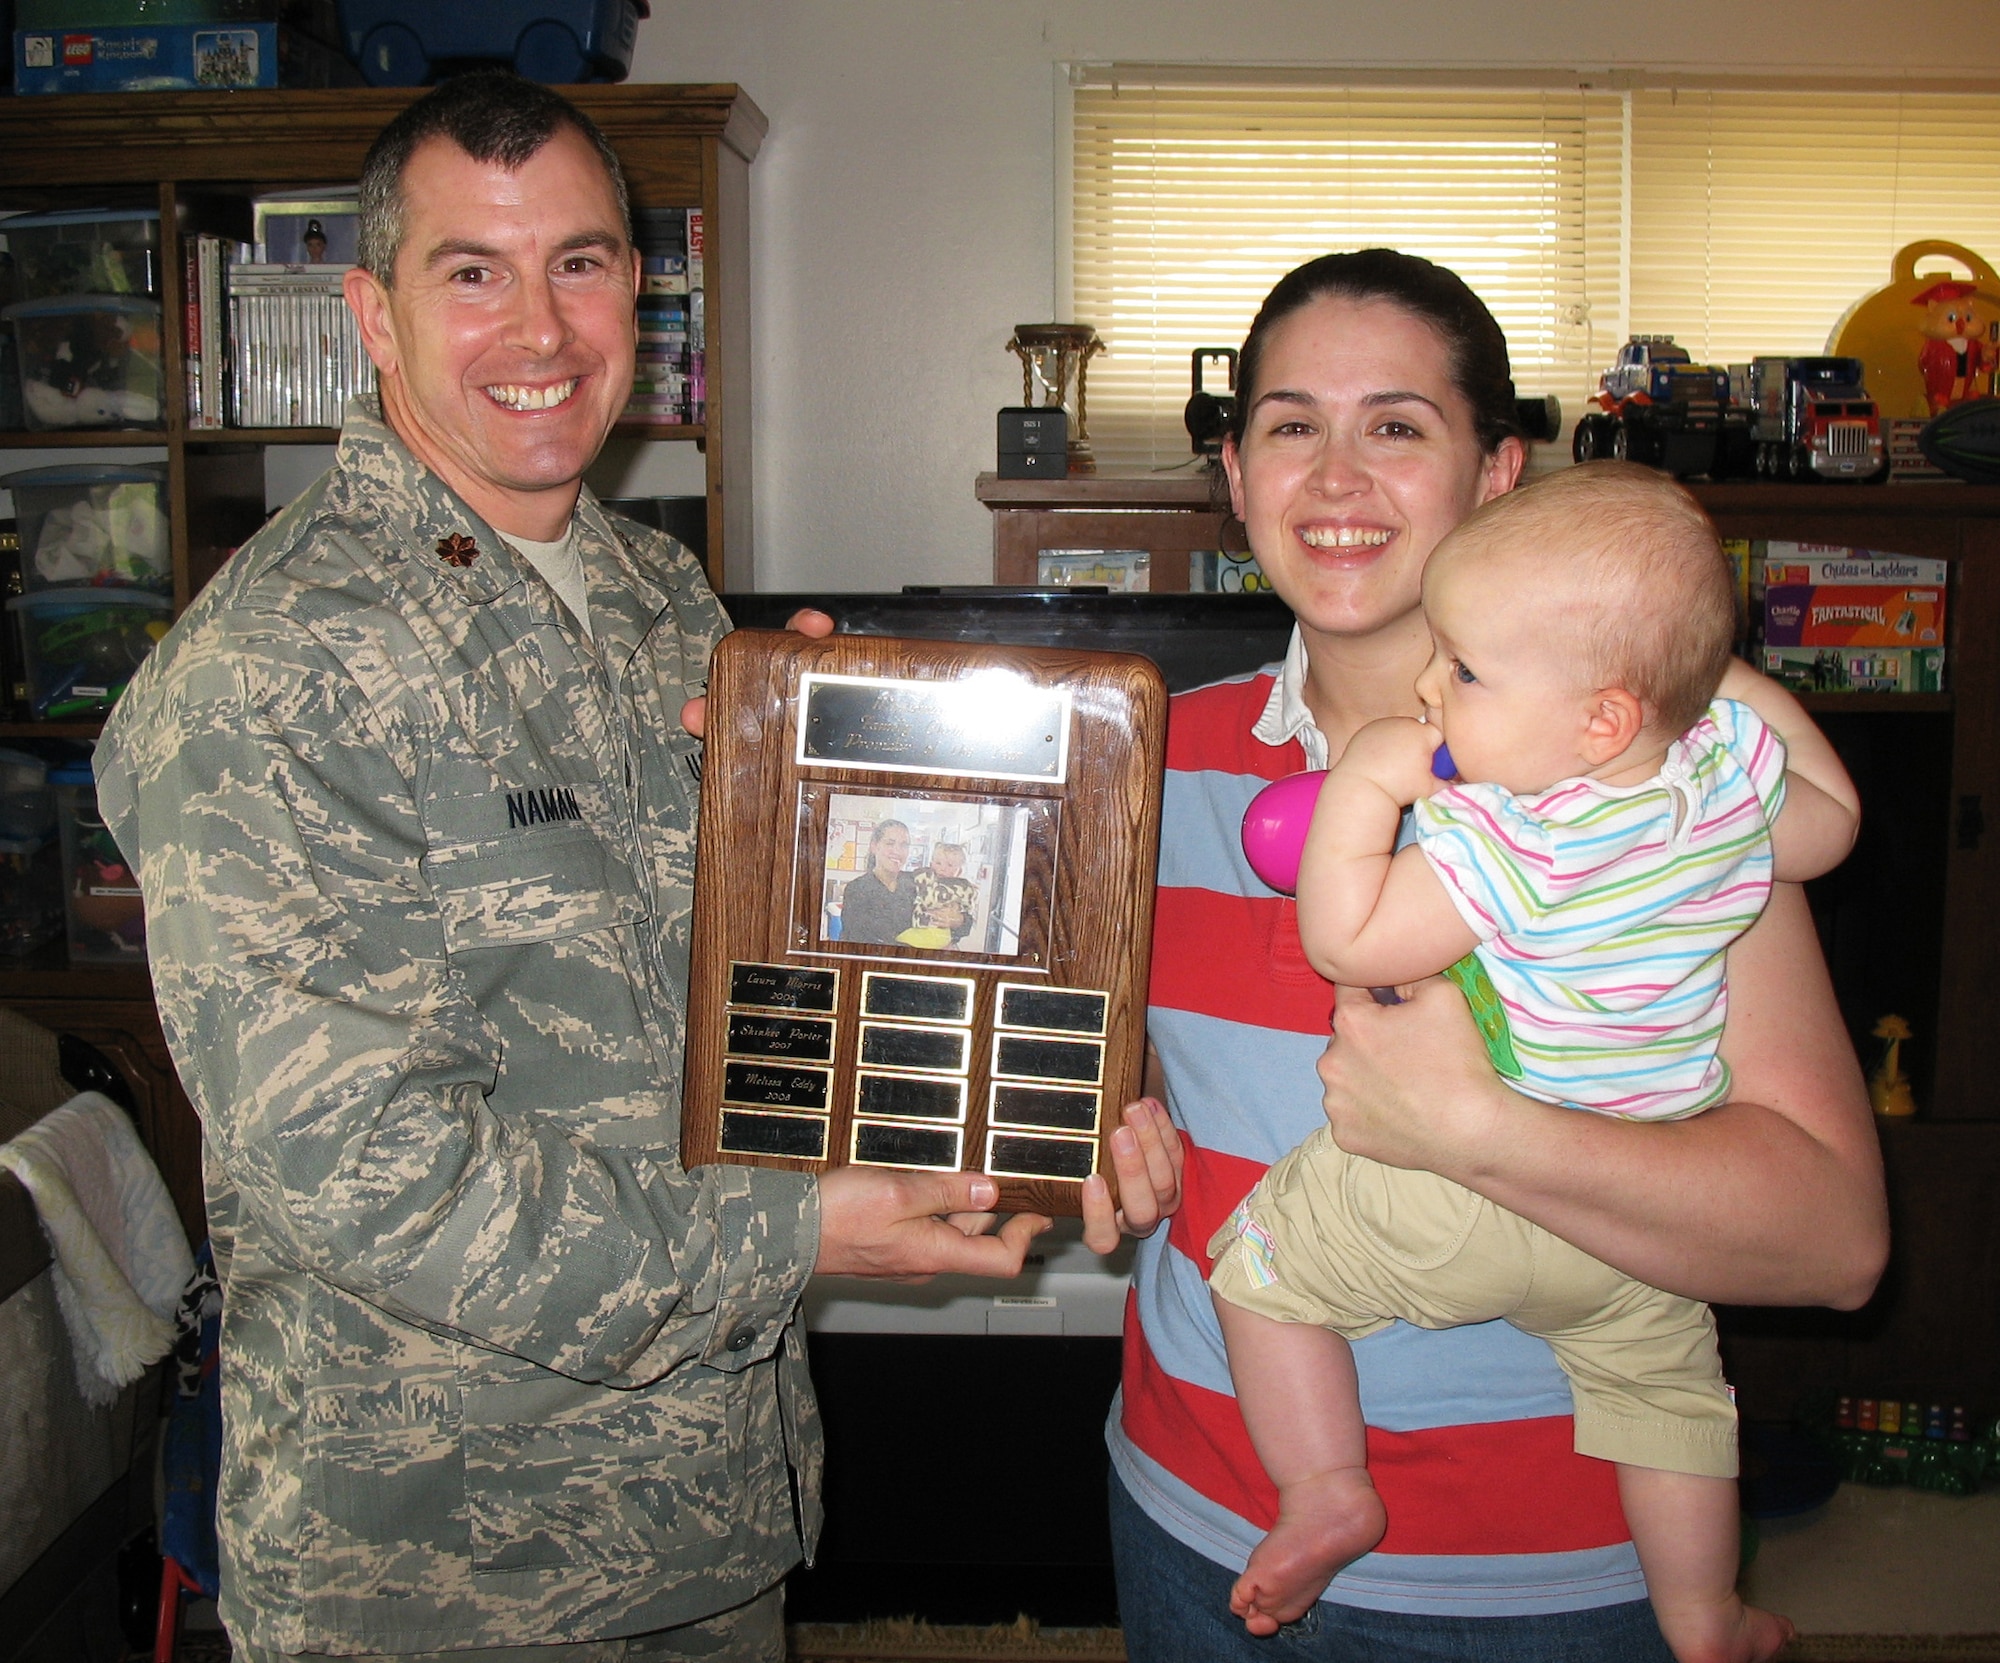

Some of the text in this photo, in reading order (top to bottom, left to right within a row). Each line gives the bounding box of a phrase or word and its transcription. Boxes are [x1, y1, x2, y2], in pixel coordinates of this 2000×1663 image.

[65, 44, 90, 55] LEGO
[1822, 562, 1859, 579] Chutes
[1871, 562, 1919, 579] Ladders
[1811, 605, 1886, 626] FANTASTICAL
[1851, 659, 1897, 677] LIFE
[506, 788, 582, 828] NAMAN
[747, 972, 822, 991] Laura Morris
[789, 1028, 823, 1041] Porter
[768, 1041, 792, 1049] 2007
[744, 1073, 817, 1092] Melissa Eddy
